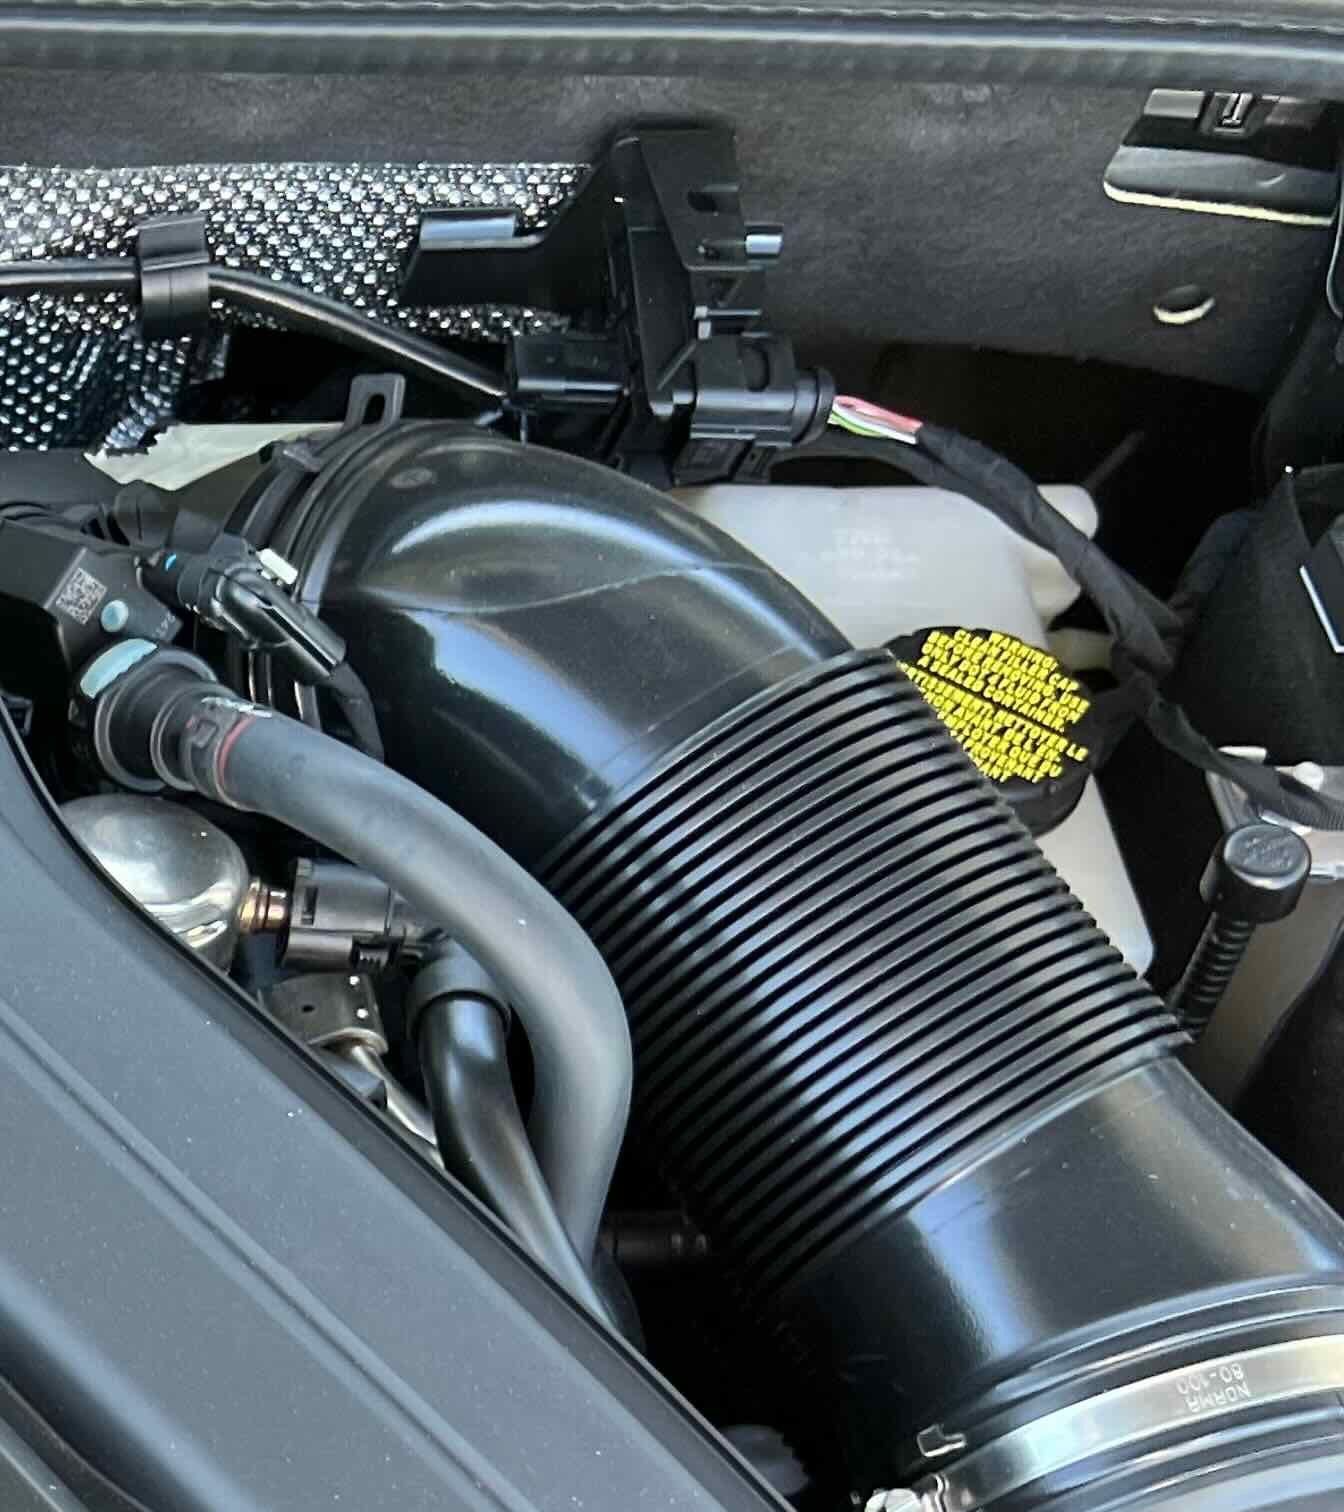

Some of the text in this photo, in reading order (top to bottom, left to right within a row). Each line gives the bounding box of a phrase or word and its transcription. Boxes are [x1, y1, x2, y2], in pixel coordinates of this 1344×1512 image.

[920, 641, 960, 668] ONLY
[998, 677, 1042, 707] FLUID
[1039, 697, 1082, 725] FROM
[927, 629, 984, 665] BEFORE
[1059, 691, 1090, 714] USE
[929, 659, 985, 694] SEALED
[953, 628, 1081, 696] CLEAN FILLER CAP
[1184, 1384, 1249, 1412] NORMA
